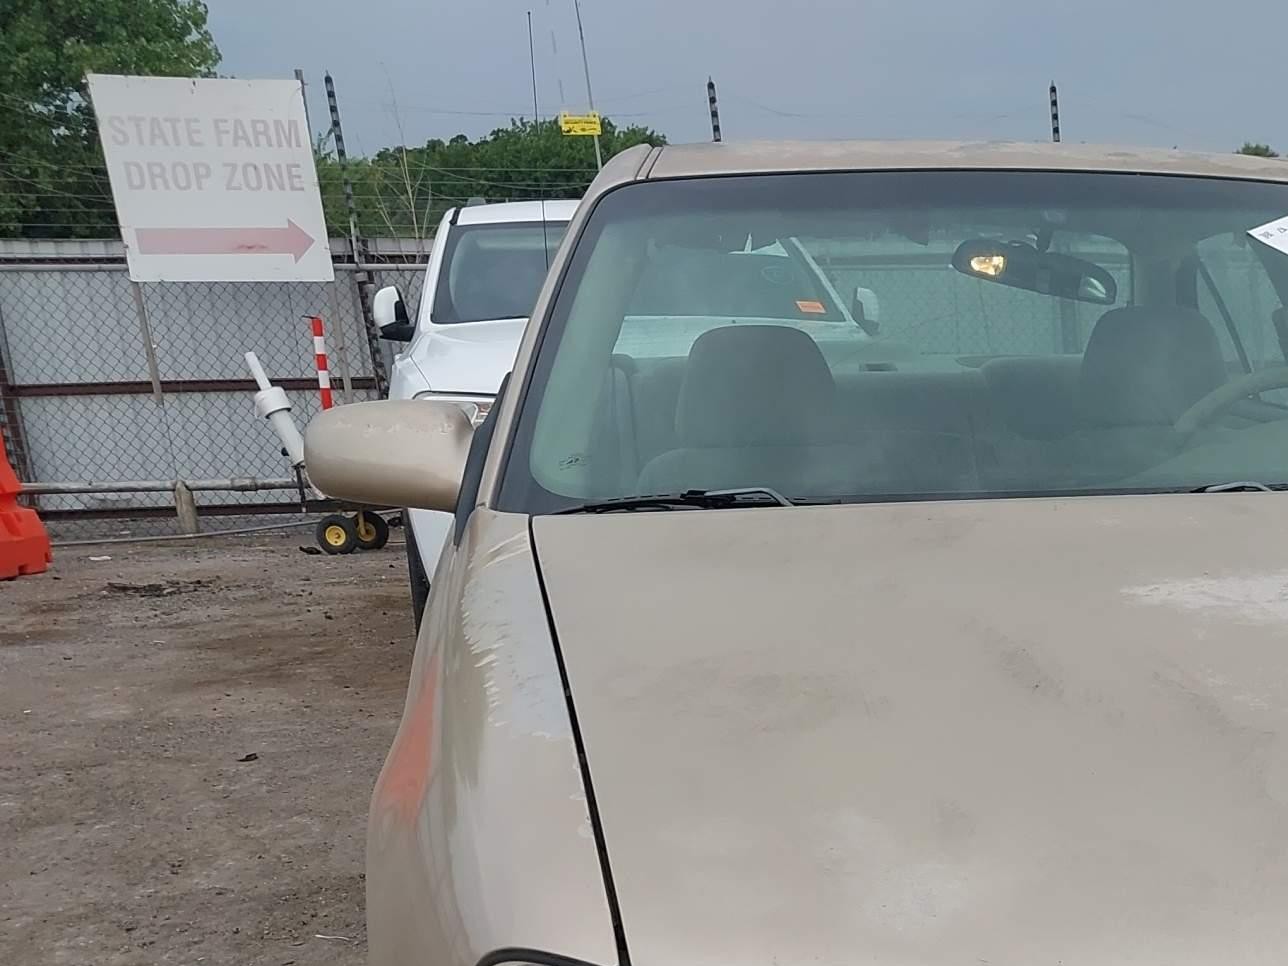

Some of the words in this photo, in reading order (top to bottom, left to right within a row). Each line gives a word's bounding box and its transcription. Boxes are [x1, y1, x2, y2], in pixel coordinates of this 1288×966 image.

[107, 115, 204, 147] STATE
[212, 118, 302, 148] FARM
[123, 161, 212, 191] DROP
[222, 162, 304, 192] ZONE
